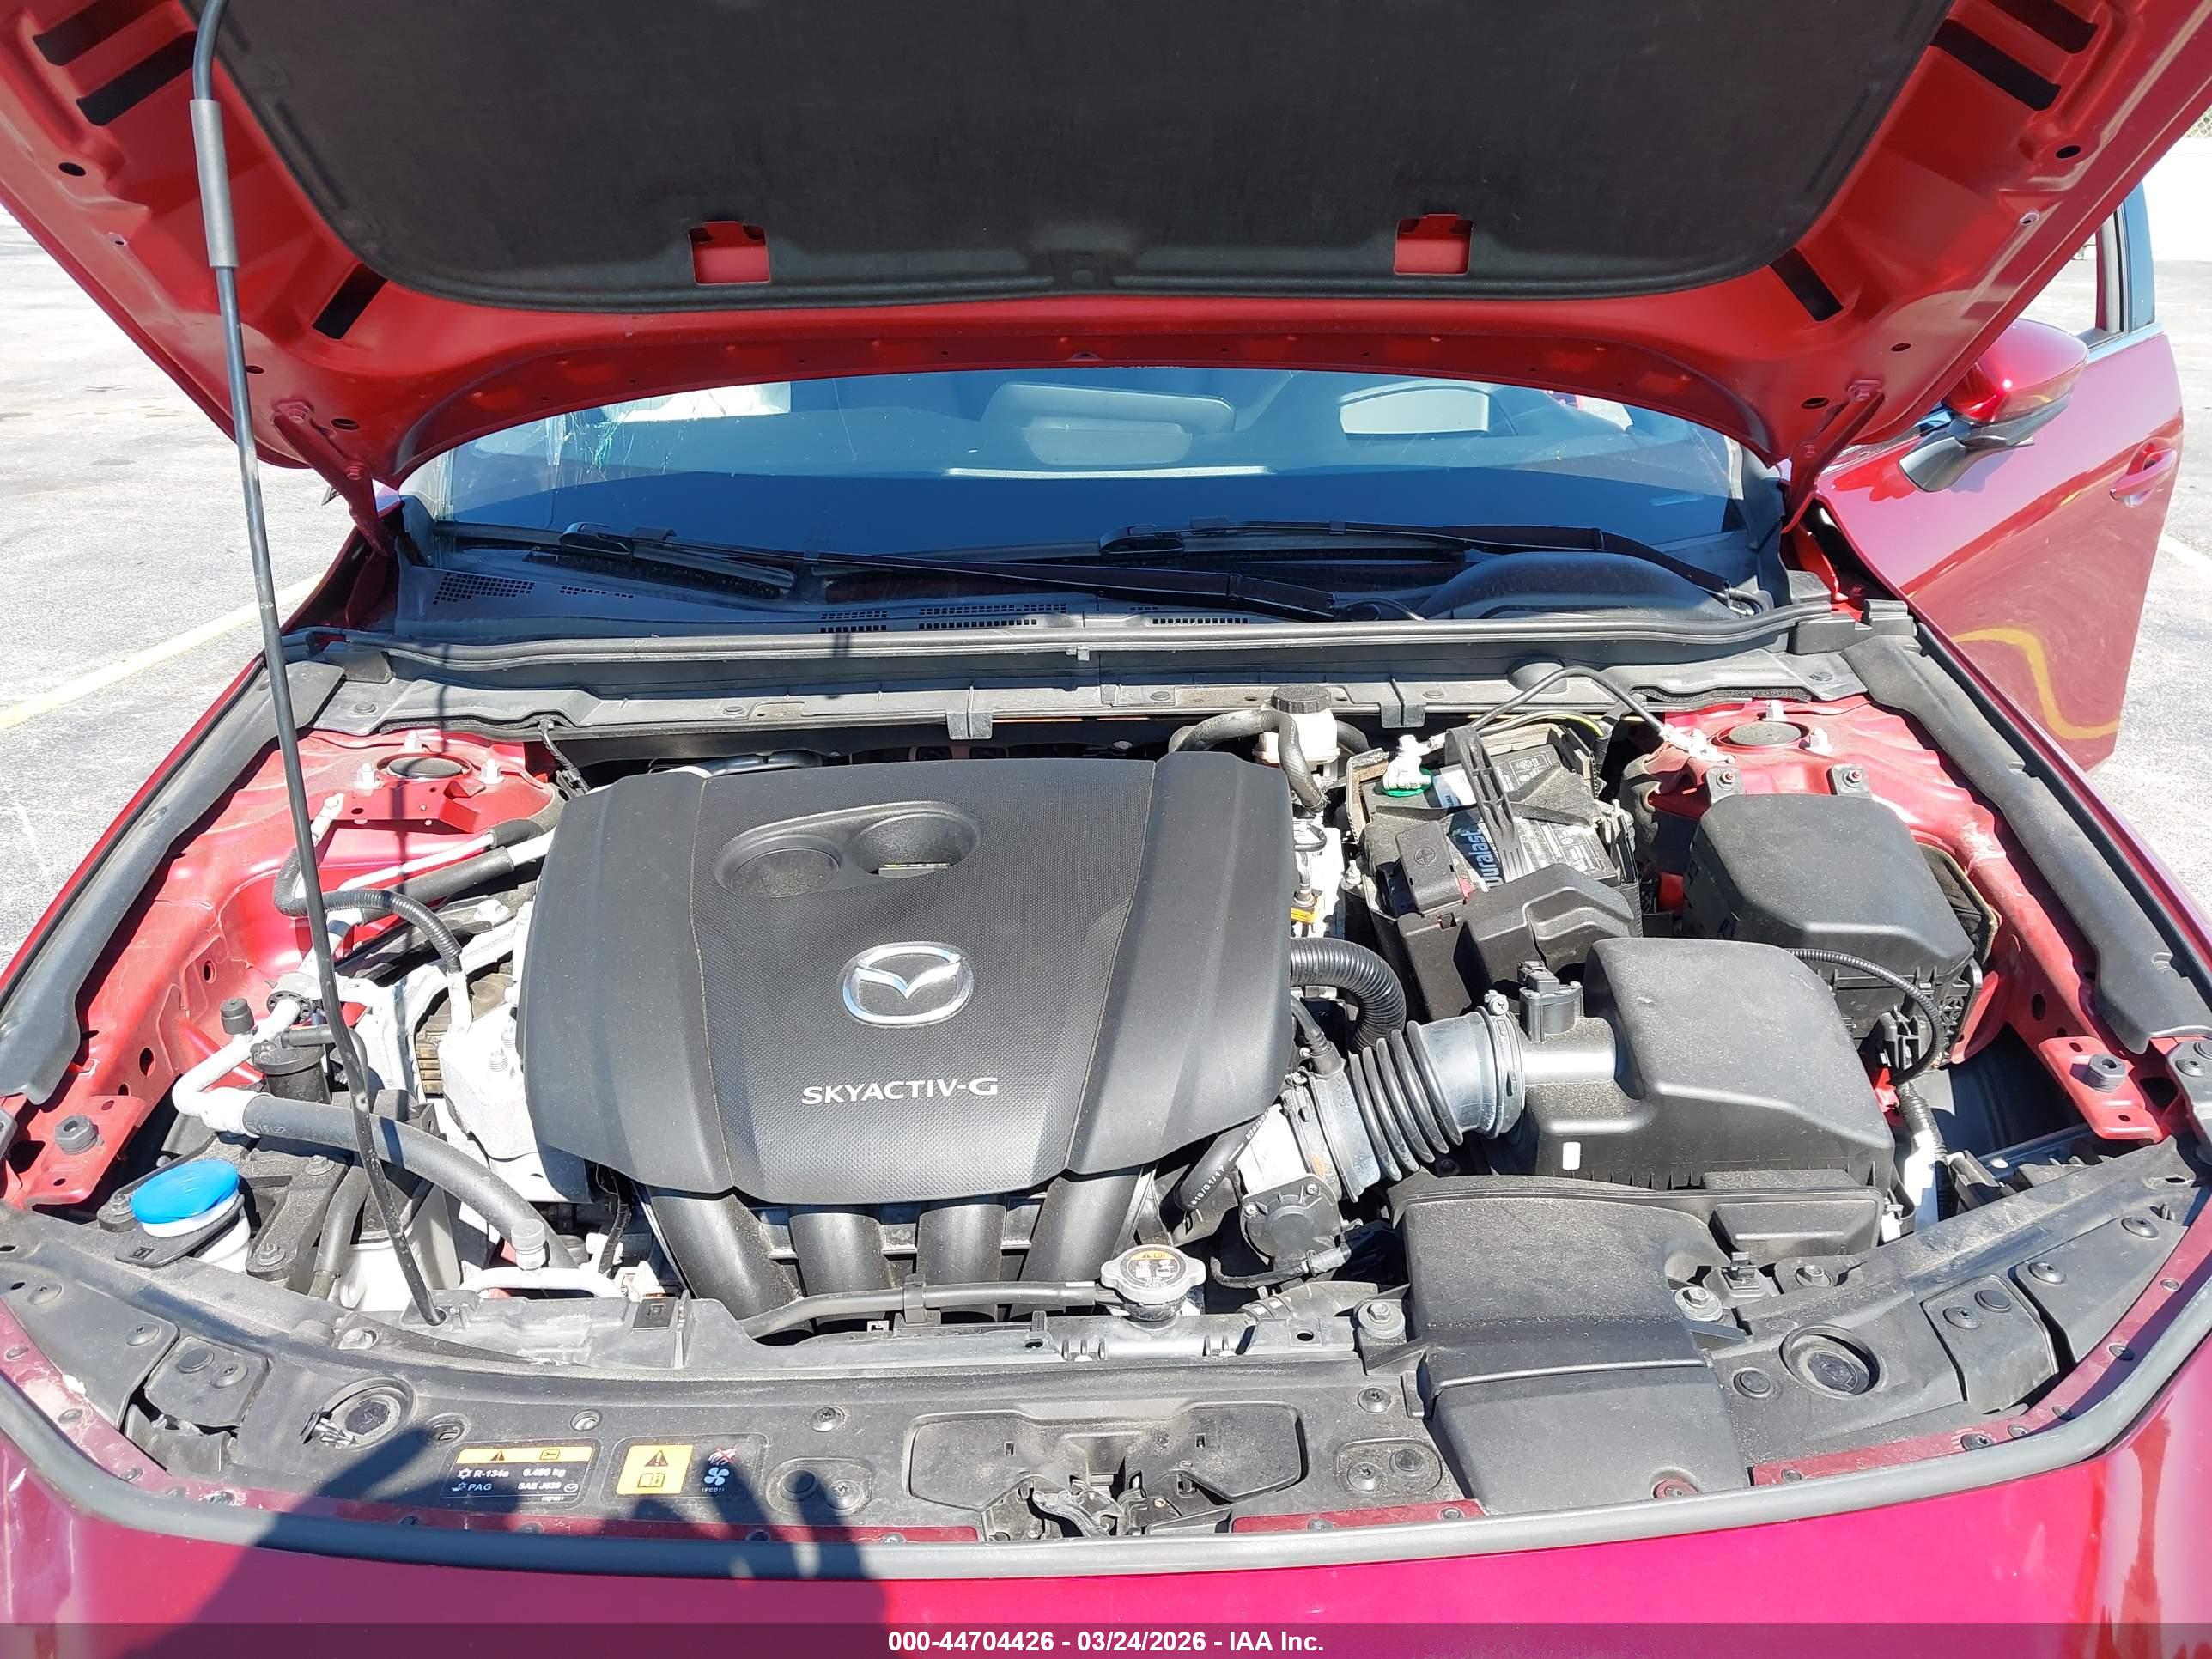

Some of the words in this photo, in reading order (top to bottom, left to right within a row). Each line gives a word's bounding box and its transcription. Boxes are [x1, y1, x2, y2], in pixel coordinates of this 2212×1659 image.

[801, 1077, 998, 1105] SKYACTIV-G
[473, 1469, 509, 1478] R-134a
[552, 1468, 566, 1478] kg
[467, 1483, 492, 1492] PAG
[517, 1482, 538, 1491] SAE
